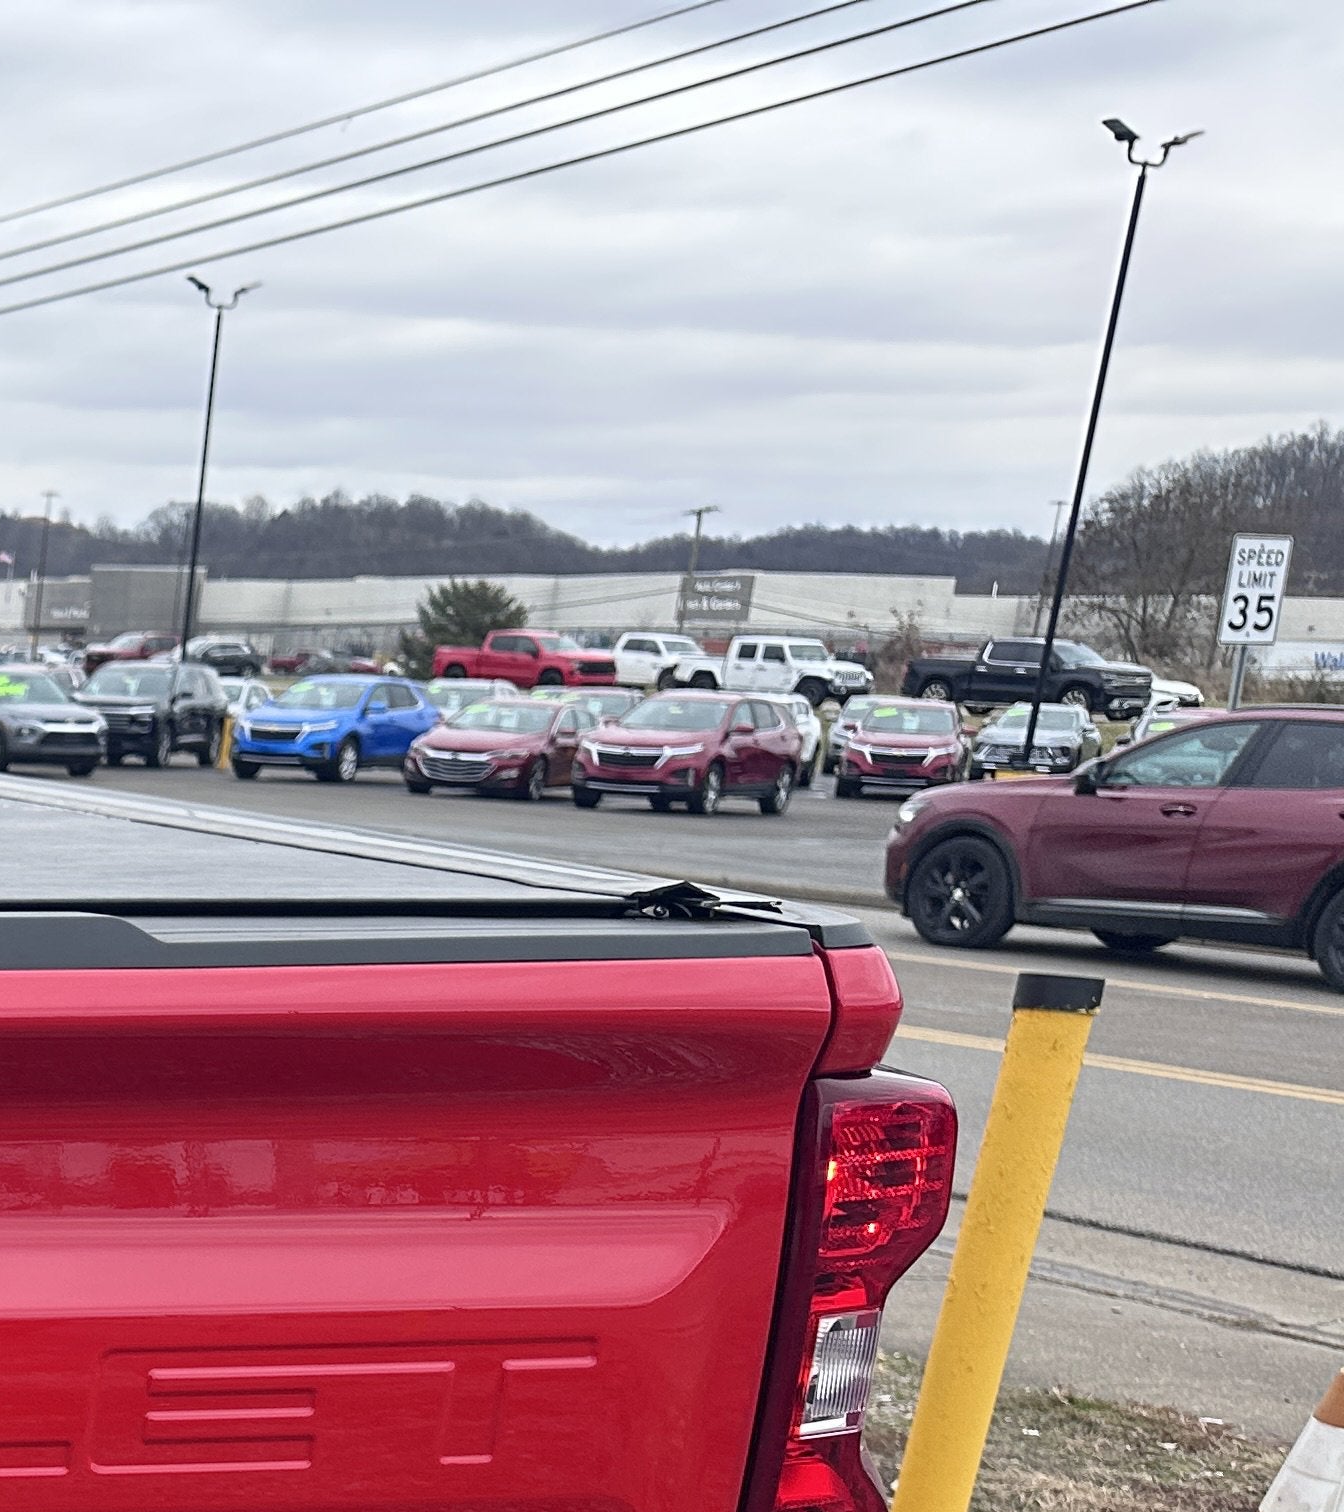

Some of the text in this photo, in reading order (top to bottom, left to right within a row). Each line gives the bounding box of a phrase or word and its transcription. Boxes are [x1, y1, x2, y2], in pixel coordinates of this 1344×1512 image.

[1237, 548, 1285, 567] SPEED
[1238, 570, 1278, 589] LIMIT
[1228, 594, 1276, 631] 35
